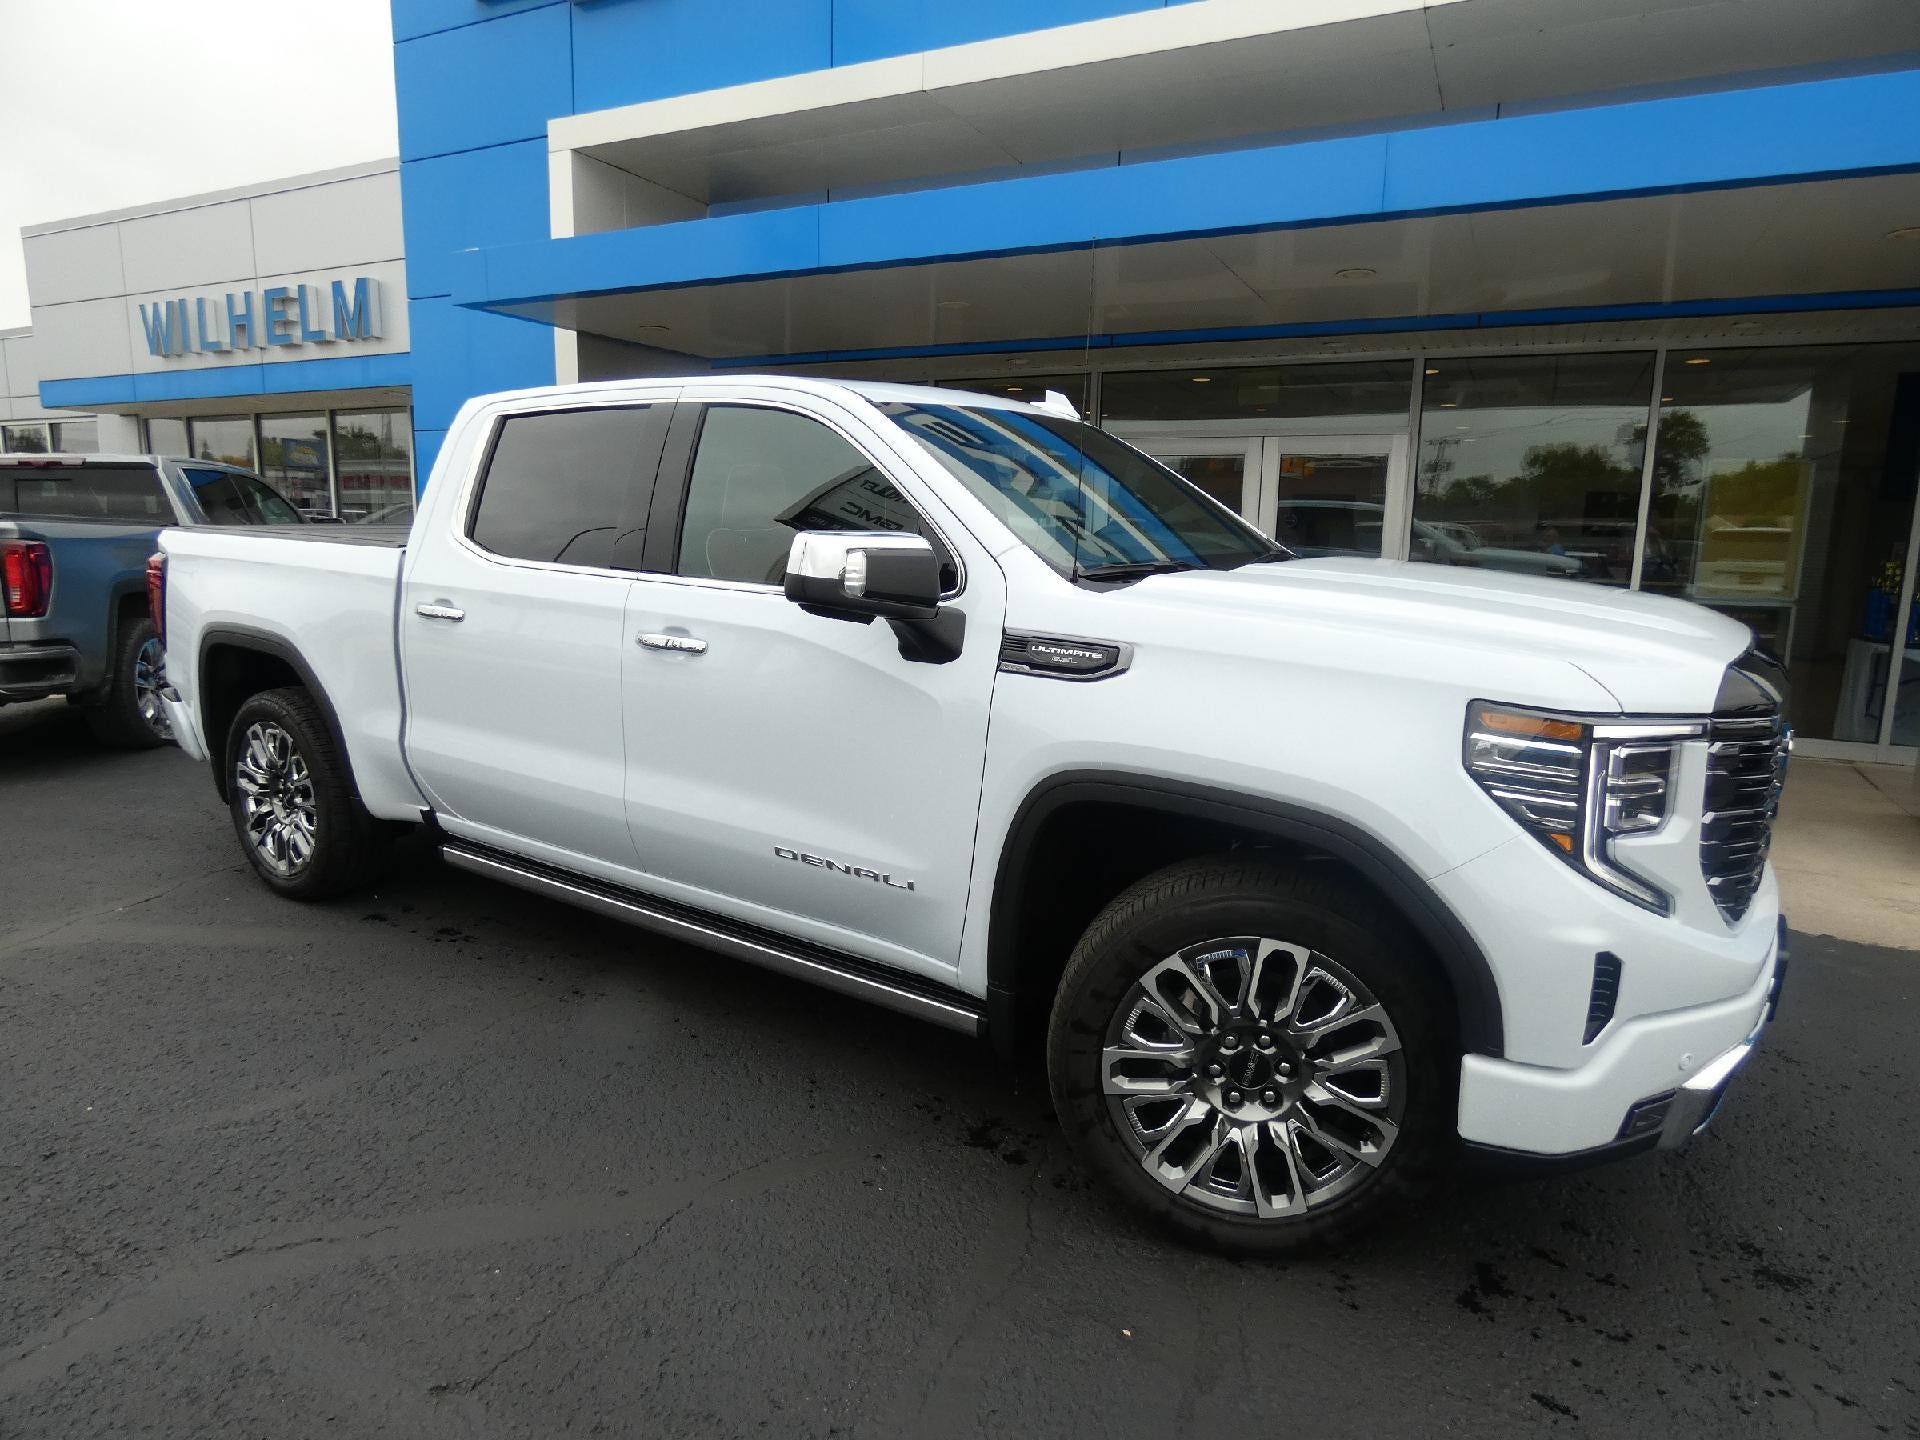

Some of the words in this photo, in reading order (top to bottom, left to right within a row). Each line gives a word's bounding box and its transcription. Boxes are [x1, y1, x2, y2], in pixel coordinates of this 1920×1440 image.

[139, 277, 372, 357] WILHELM
[1031, 645, 1103, 659] ULTIMATE
[773, 845, 915, 891] DENALI
